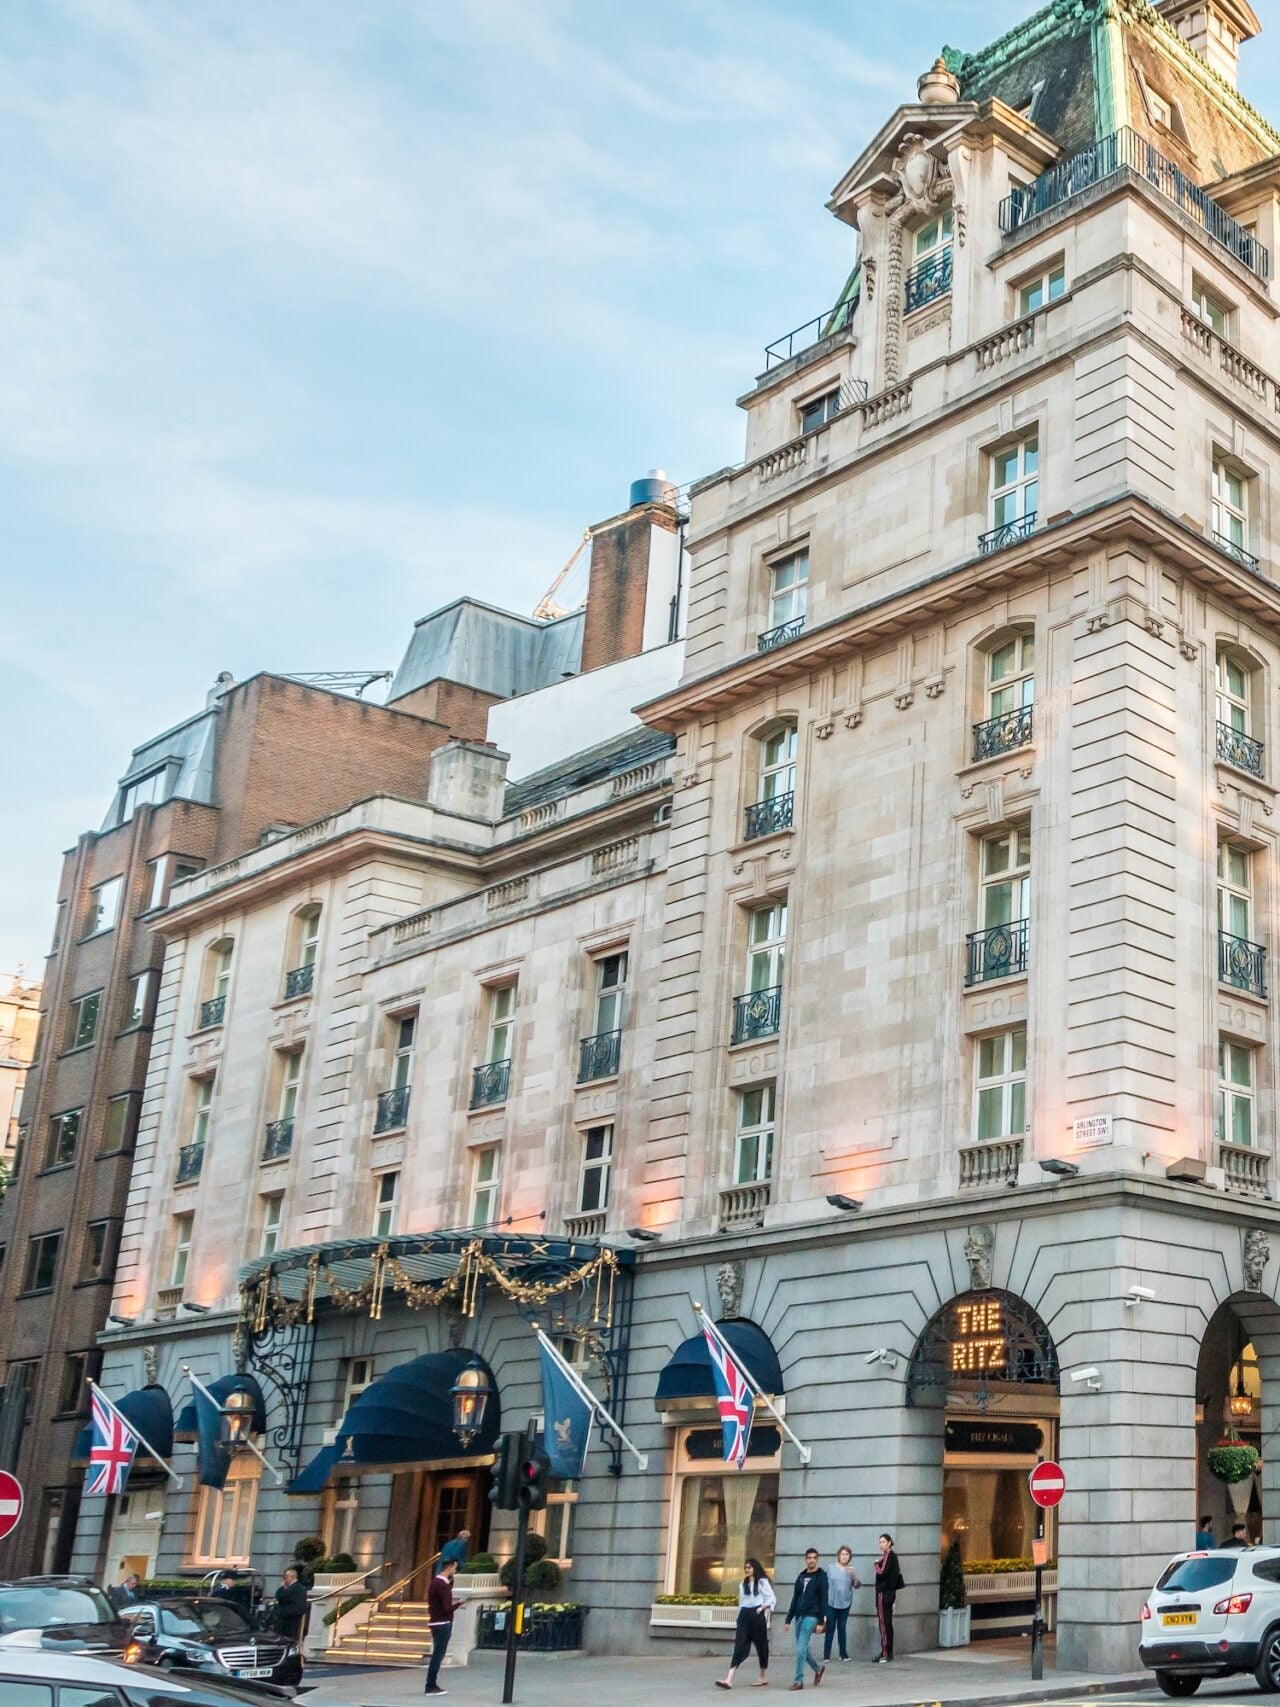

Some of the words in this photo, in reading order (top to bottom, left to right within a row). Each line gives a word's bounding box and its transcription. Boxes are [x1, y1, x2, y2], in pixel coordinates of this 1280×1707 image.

[1076, 1118, 1107, 1130] ARLINGTON
[1076, 1128, 1096, 1139] STREET
[1097, 1126, 1109, 1136] SW1
[957, 1303, 1000, 1333] THE
[953, 1338, 1004, 1371] RITZ
